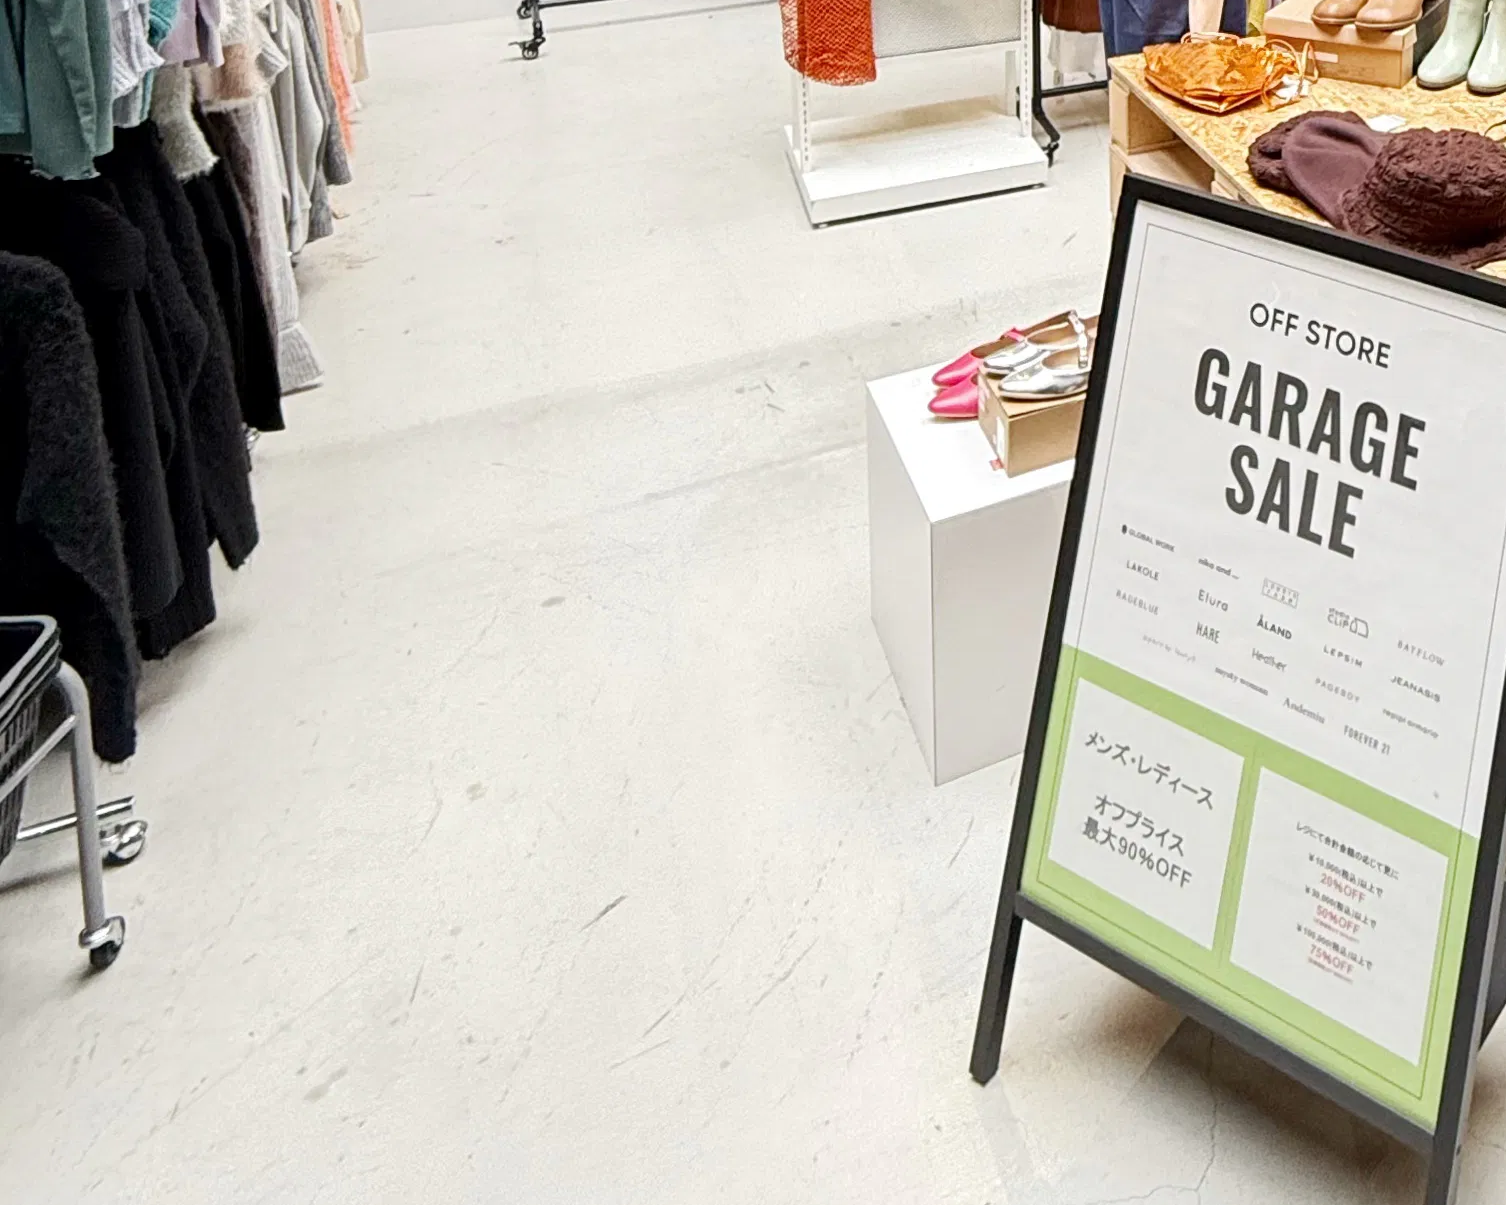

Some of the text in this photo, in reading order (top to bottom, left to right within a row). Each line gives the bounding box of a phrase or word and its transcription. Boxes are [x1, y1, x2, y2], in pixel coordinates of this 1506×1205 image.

[1250, 302, 1391, 369] OFF STORE
[1194, 347, 1427, 491] GARAGE
[1225, 444, 1364, 559] SALE
[1128, 528, 1153, 545] GLOBAL
[1126, 559, 1160, 581] LAKOLE
[1197, 588, 1229, 612] Elura
[1195, 621, 1221, 644] HARE
[1256, 614, 1293, 640] ÅLAND
[1251, 648, 1288, 672] Heather
[1397, 639, 1445, 667] BAYFLOW
[1315, 677, 1360, 703] PAGEBOY
[1343, 724, 1392, 756] FOREVER 21
[1084, 731, 1213, 811] メンズ・レディース
[1094, 794, 1184, 857] オフプライス
[1082, 816, 1192, 888] 最大90%OFF
[1320, 872, 1366, 902] 20%OFF
[1316, 904, 1361, 934] 50%OFF
